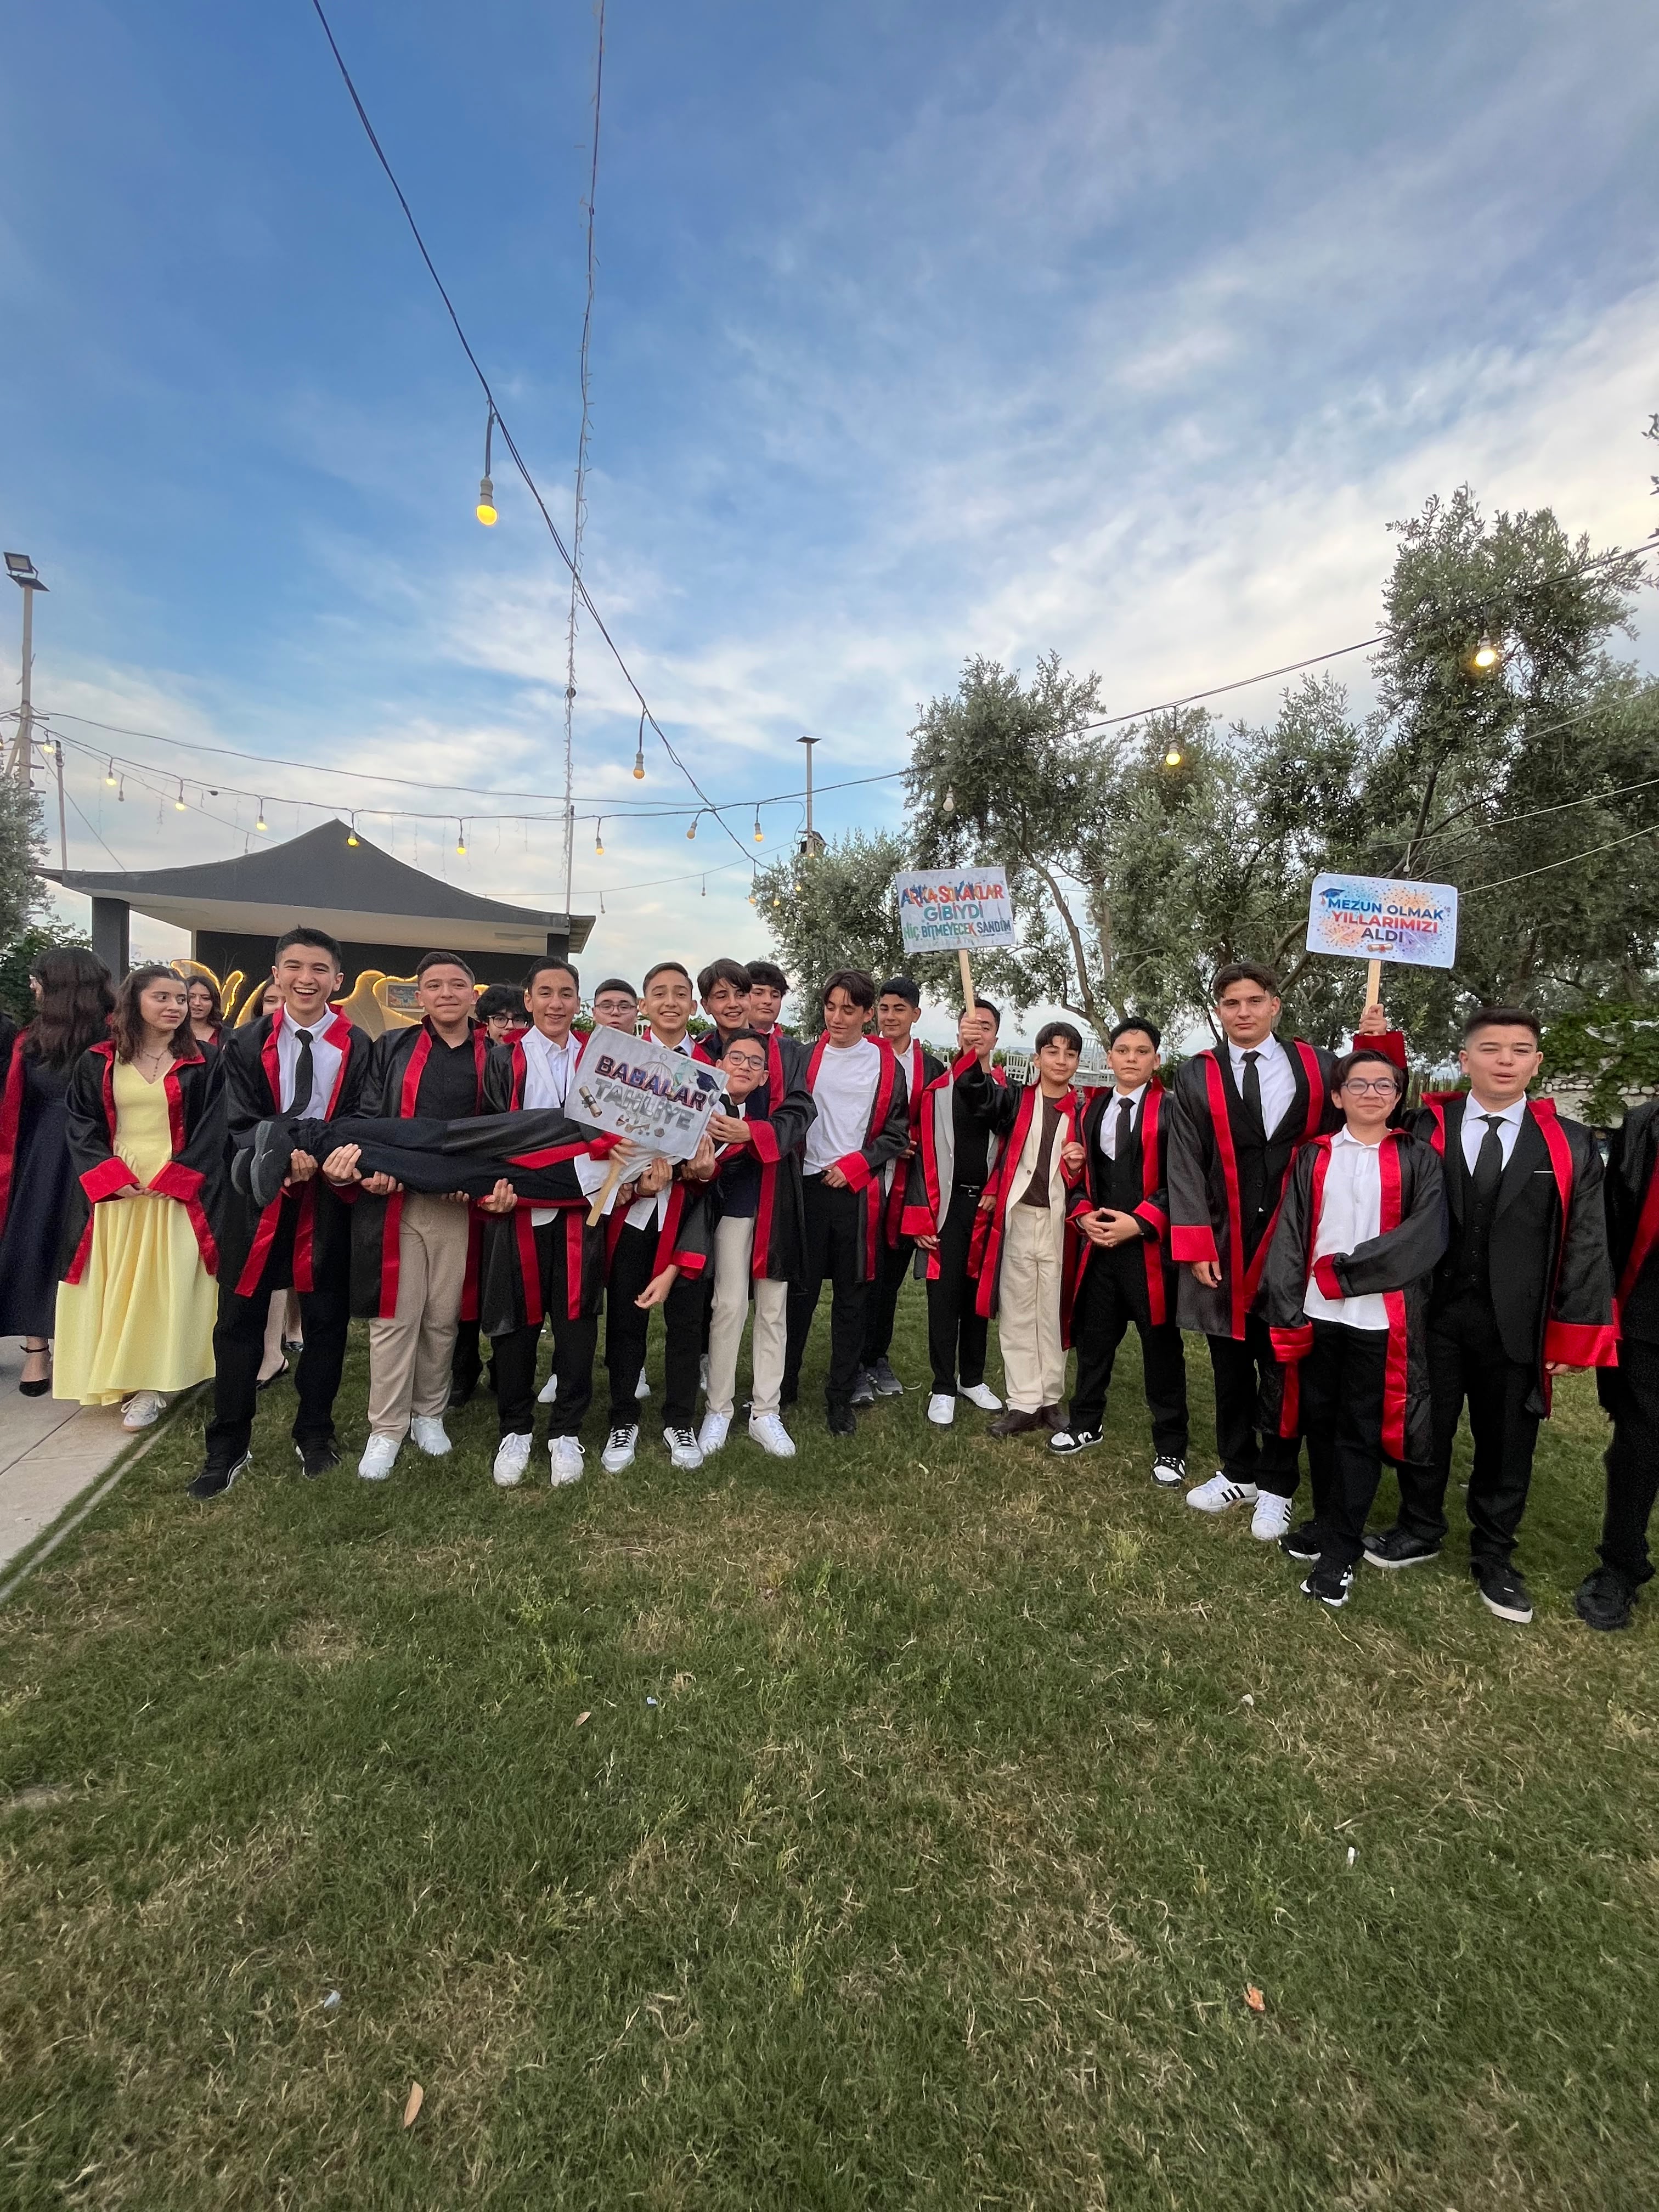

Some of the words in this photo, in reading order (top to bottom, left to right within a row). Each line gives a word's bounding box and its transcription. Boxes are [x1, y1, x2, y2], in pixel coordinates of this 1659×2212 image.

[924, 901, 984, 922] GİBİYDİ
[1328, 898, 1382, 913] MEZUN
[1387, 905, 1444, 921] OLMAK
[1332, 910, 1438, 934] YILLARIMIZI
[1361, 927, 1403, 943] ALDI
[595, 1054, 708, 1111] BABALAR
[595, 1078, 696, 1131] TAHLİYE
